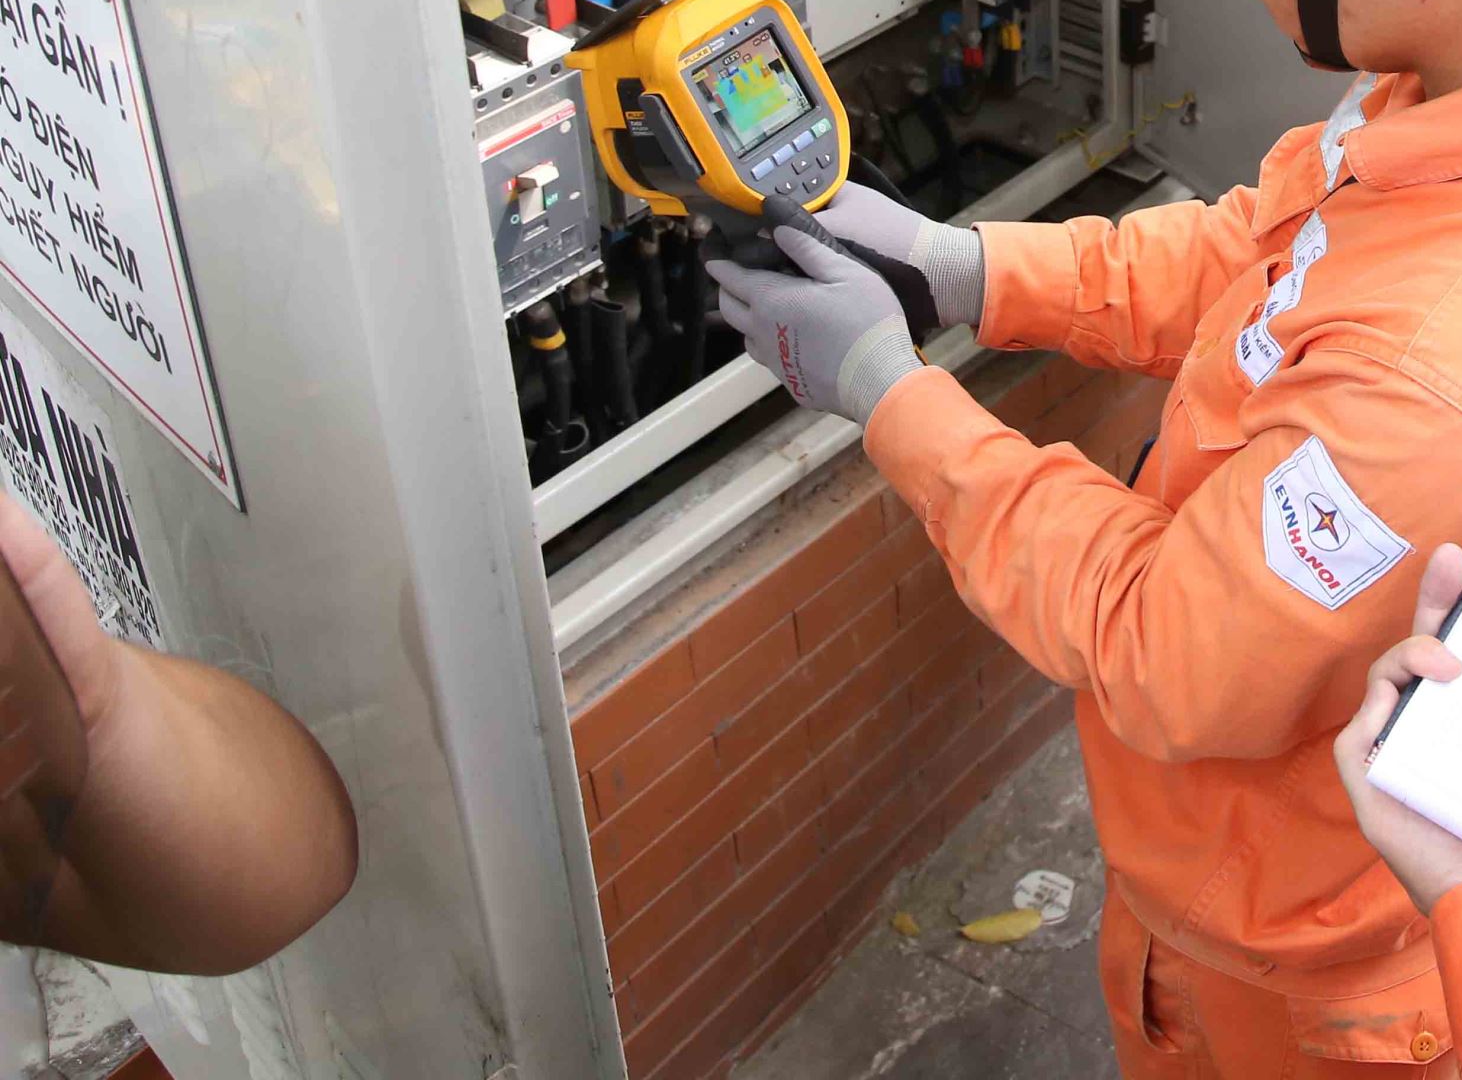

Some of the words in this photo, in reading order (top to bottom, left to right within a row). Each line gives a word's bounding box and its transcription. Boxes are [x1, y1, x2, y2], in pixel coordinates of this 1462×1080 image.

[109, 60, 127, 122] !
[683, 48, 710, 66] FLUKE
[26, 97, 100, 191] ĐIỆN
[0, 136, 57, 215] GUY
[64, 191, 144, 293] HIỂM
[0, 186, 64, 275] CHẾT
[70, 252, 173, 375] NGƯỜI
[41, 385, 152, 595] NHÀ
[1274, 484, 1342, 590] EVNHANOI
[131, 578, 161, 638] 929
